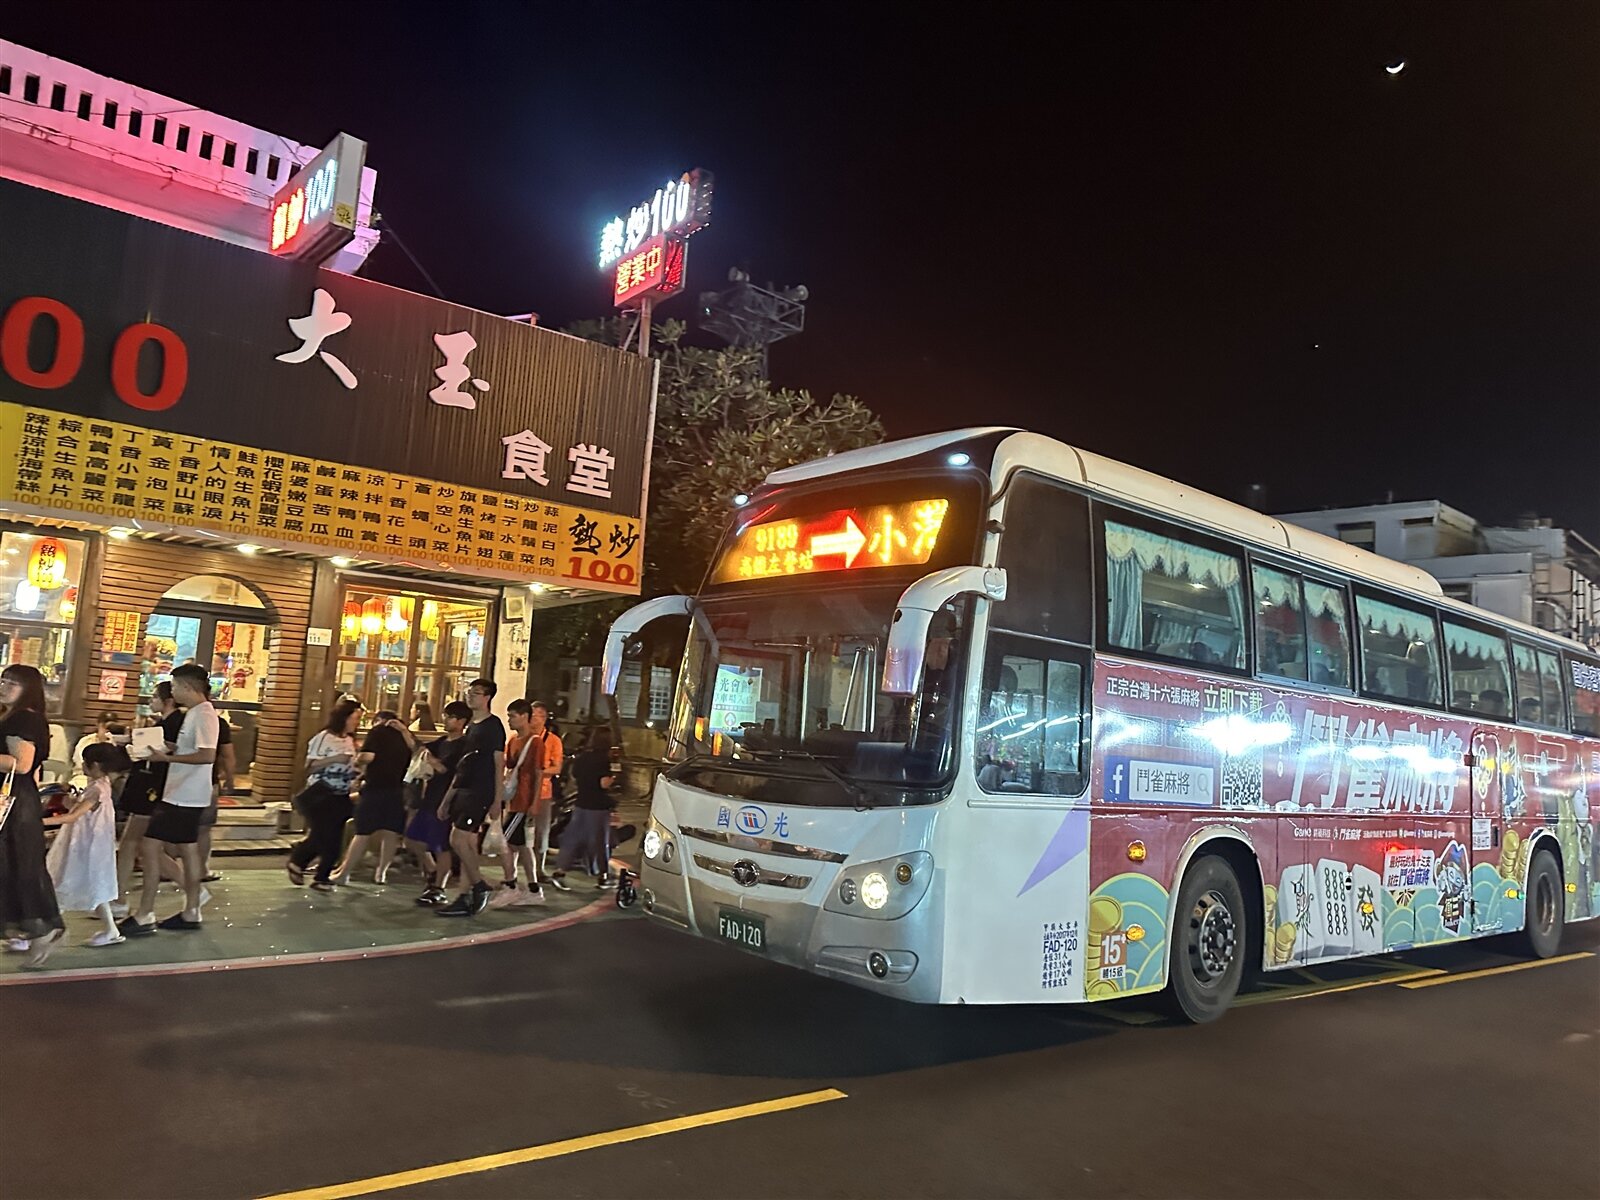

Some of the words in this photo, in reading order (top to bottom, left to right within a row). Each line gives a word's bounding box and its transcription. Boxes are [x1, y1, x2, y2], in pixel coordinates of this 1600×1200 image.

[615, 244, 662, 294] 營業中
[275, 287, 490, 410] 大玉
[501, 429, 616, 499] 食堂
[15, 412, 50, 493] 辣味涼拌海帶絲
[50, 418, 83, 497] 綜合生魚片
[81, 424, 113, 502] 鴨賞高麗菜
[143, 435, 174, 511] 黃金泡菜
[174, 440, 202, 515] 丁香野山蘇
[202, 446, 232, 520] 情人的眼淚
[230, 450, 258, 523] 鮭魚生魚片
[257, 456, 285, 528] 櫻花蝦高麗菜
[284, 460, 310, 532] 麻婆嫩豆腐
[310, 465, 336, 535] 鹹蛋苦瓜
[336, 470, 360, 539] 麻辣鴨血
[361, 474, 386, 542] 涼拌鴨賞
[385, 478, 409, 546] 丁香花生
[409, 482, 432, 549] 蒼蠅頭
[432, 487, 454, 552] 炒空心菜
[455, 491, 476, 556] 旗魚生魚片
[477, 494, 498, 558] 鹽烤雞翅
[13, 493, 40, 505] 100
[45, 498, 73, 510] 100
[76, 502, 105, 514] 100
[109, 506, 136, 518] 100
[140, 511, 166, 522] 100
[170, 514, 194, 526] 100
[227, 524, 250, 535] 100
[255, 527, 277, 538] 100
[282, 531, 304, 542] 100
[308, 535, 330, 546] 100
[332, 539, 355, 549] 100
[358, 542, 379, 552] 100
[384, 545, 403, 555] 100
[406, 548, 426, 560] 100
[430, 552, 449, 563] 100
[452, 556, 472, 566] 100
[474, 558, 493, 568] 100
[496, 562, 514, 572] 100
[517, 564, 536, 574] 100
[537, 567, 556, 577] 100
[540, 506, 560, 567] 蒜泥白肉
[568, 514, 640, 558] 熱炒
[568, 557, 634, 584] 100
[1106, 677, 1200, 708] 正宗台灣十六張麻將
[1203, 685, 1263, 719] 立即下載
[718, 806, 730, 828] 國
[772, 812, 789, 838] 光
[720, 918, 761, 946] FAD-120
[1043, 938, 1078, 953] FAD-120
